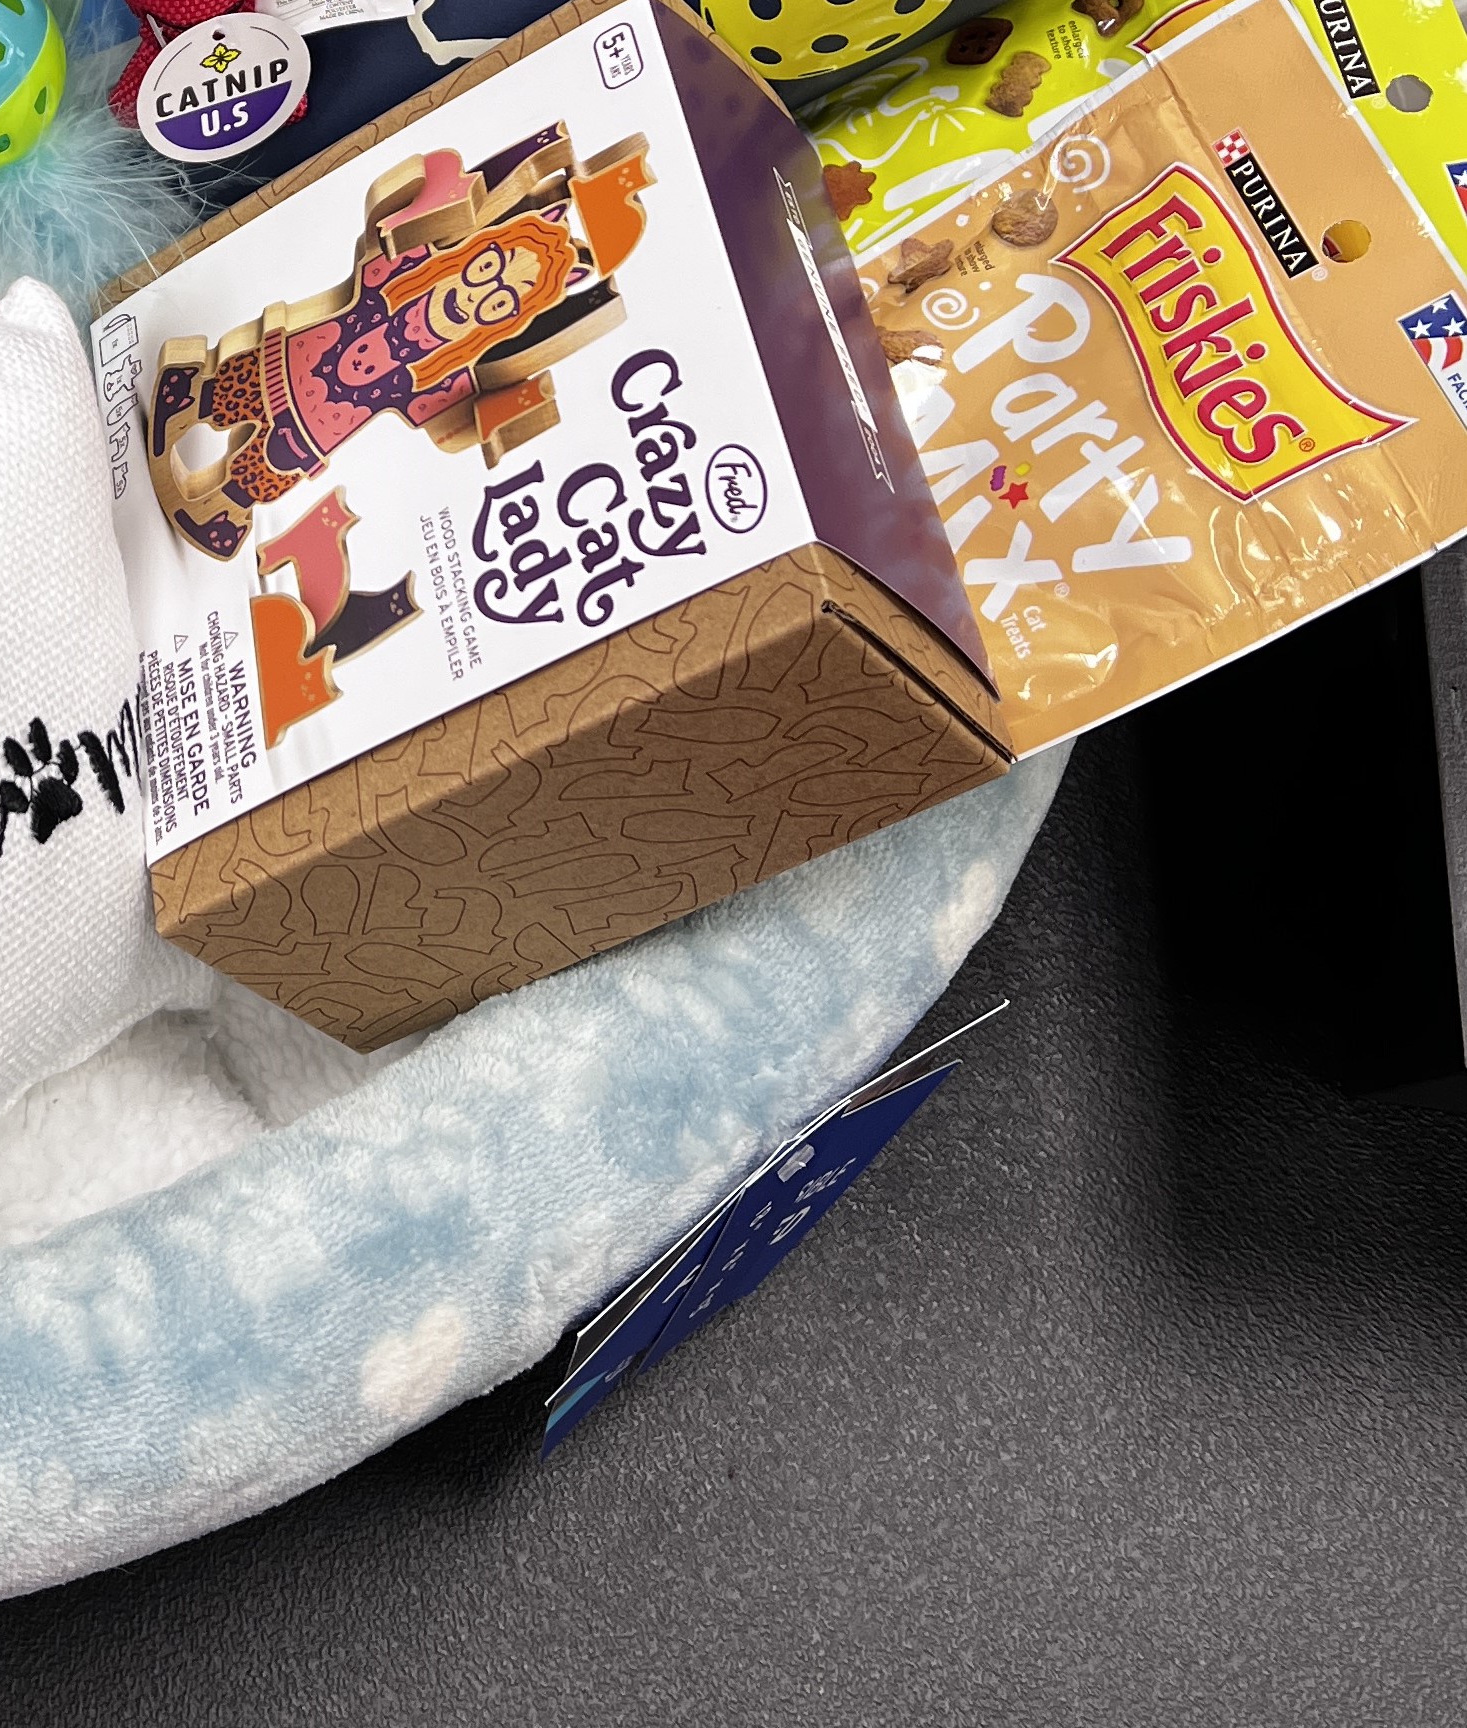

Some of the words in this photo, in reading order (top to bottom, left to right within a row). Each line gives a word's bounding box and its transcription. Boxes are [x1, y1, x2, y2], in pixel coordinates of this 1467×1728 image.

[602, 32, 625, 59] 5+
[155, 58, 289, 118] CATNIP
[199, 100, 249, 137] U.S
[1232, 159, 1309, 273] PURINA
[1103, 195, 1305, 465] Friskies
[952, 272, 1193, 573] Party
[611, 348, 707, 557] Crazy
[715, 462, 758, 519] Fred
[419, 514, 431, 540] JEU
[425, 541, 435, 560] EN
[472, 459, 572, 624] Lady
[556, 462, 645, 627] Cat
[429, 562, 448, 601] BOIS
[438, 506, 457, 551] WOOD
[451, 551, 473, 622] STACKING
[462, 625, 483, 670] GAME
[207, 611, 224, 663] CHOKING
[1000, 612, 1031, 659] Treats
[1023, 605, 1047, 632] Cat
[147, 650, 161, 692] PIÈCES
[440, 615, 464, 682] EMPILER
[152, 690, 163, 706] DE
[163, 661, 179, 708] RISQUE
[177, 657, 196, 710] MISE
[214, 663, 230, 713] HAZARD
[153, 706, 169, 758] PETITES
[183, 709, 201, 741] EN
[229, 659, 257, 769] WARNING
[221, 718, 236, 764] SMALL
[158, 758, 178, 833] DIMENSIONS
[188, 743, 210, 816] GARDE
[227, 763, 243, 805] PARTS
